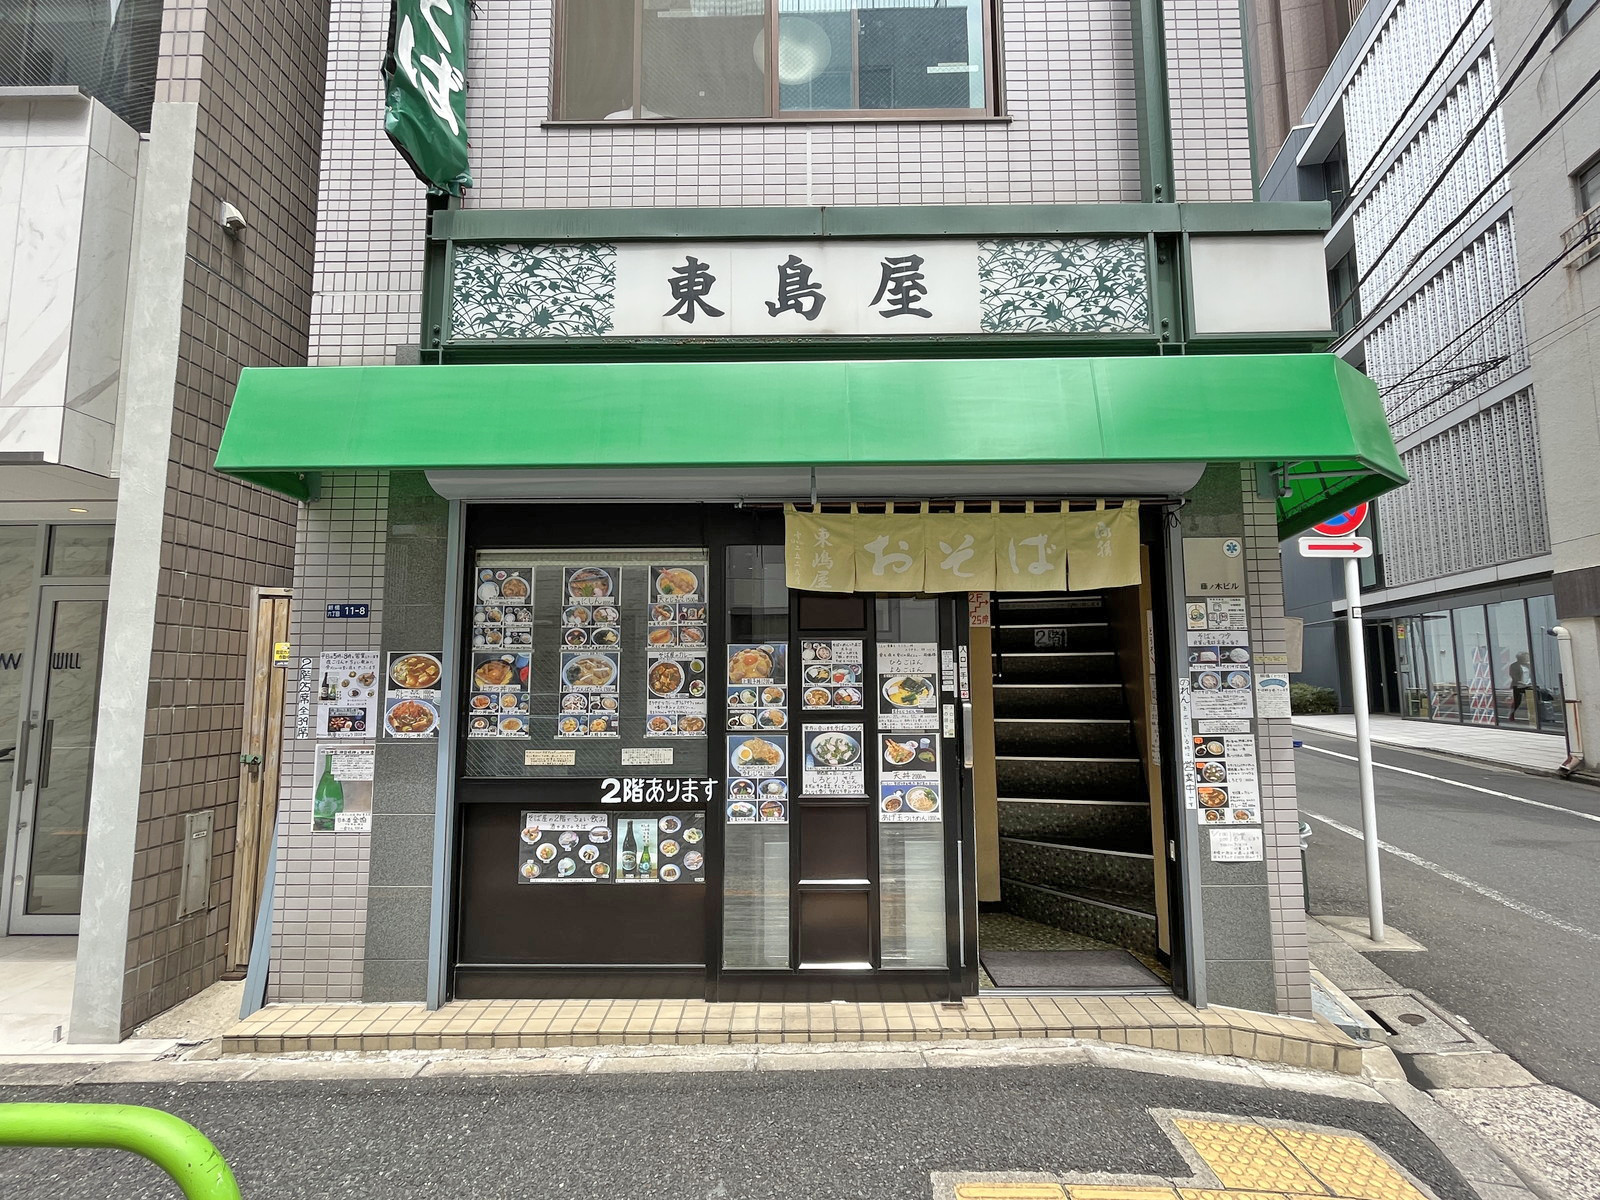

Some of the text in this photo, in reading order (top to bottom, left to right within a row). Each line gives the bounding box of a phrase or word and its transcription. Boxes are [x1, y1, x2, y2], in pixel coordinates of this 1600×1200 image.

[662, 254, 933, 324] 東島屋
[863, 532, 1055, 578] おそば
[968, 593, 983, 602] 2F
[344, 606, 366, 615] 11-8
[52, 652, 81, 669] WILL
[960, 646, 967, 662] 入口
[893, 771, 910, 780] 天丼
[600, 777, 719, 804] 2階あります
